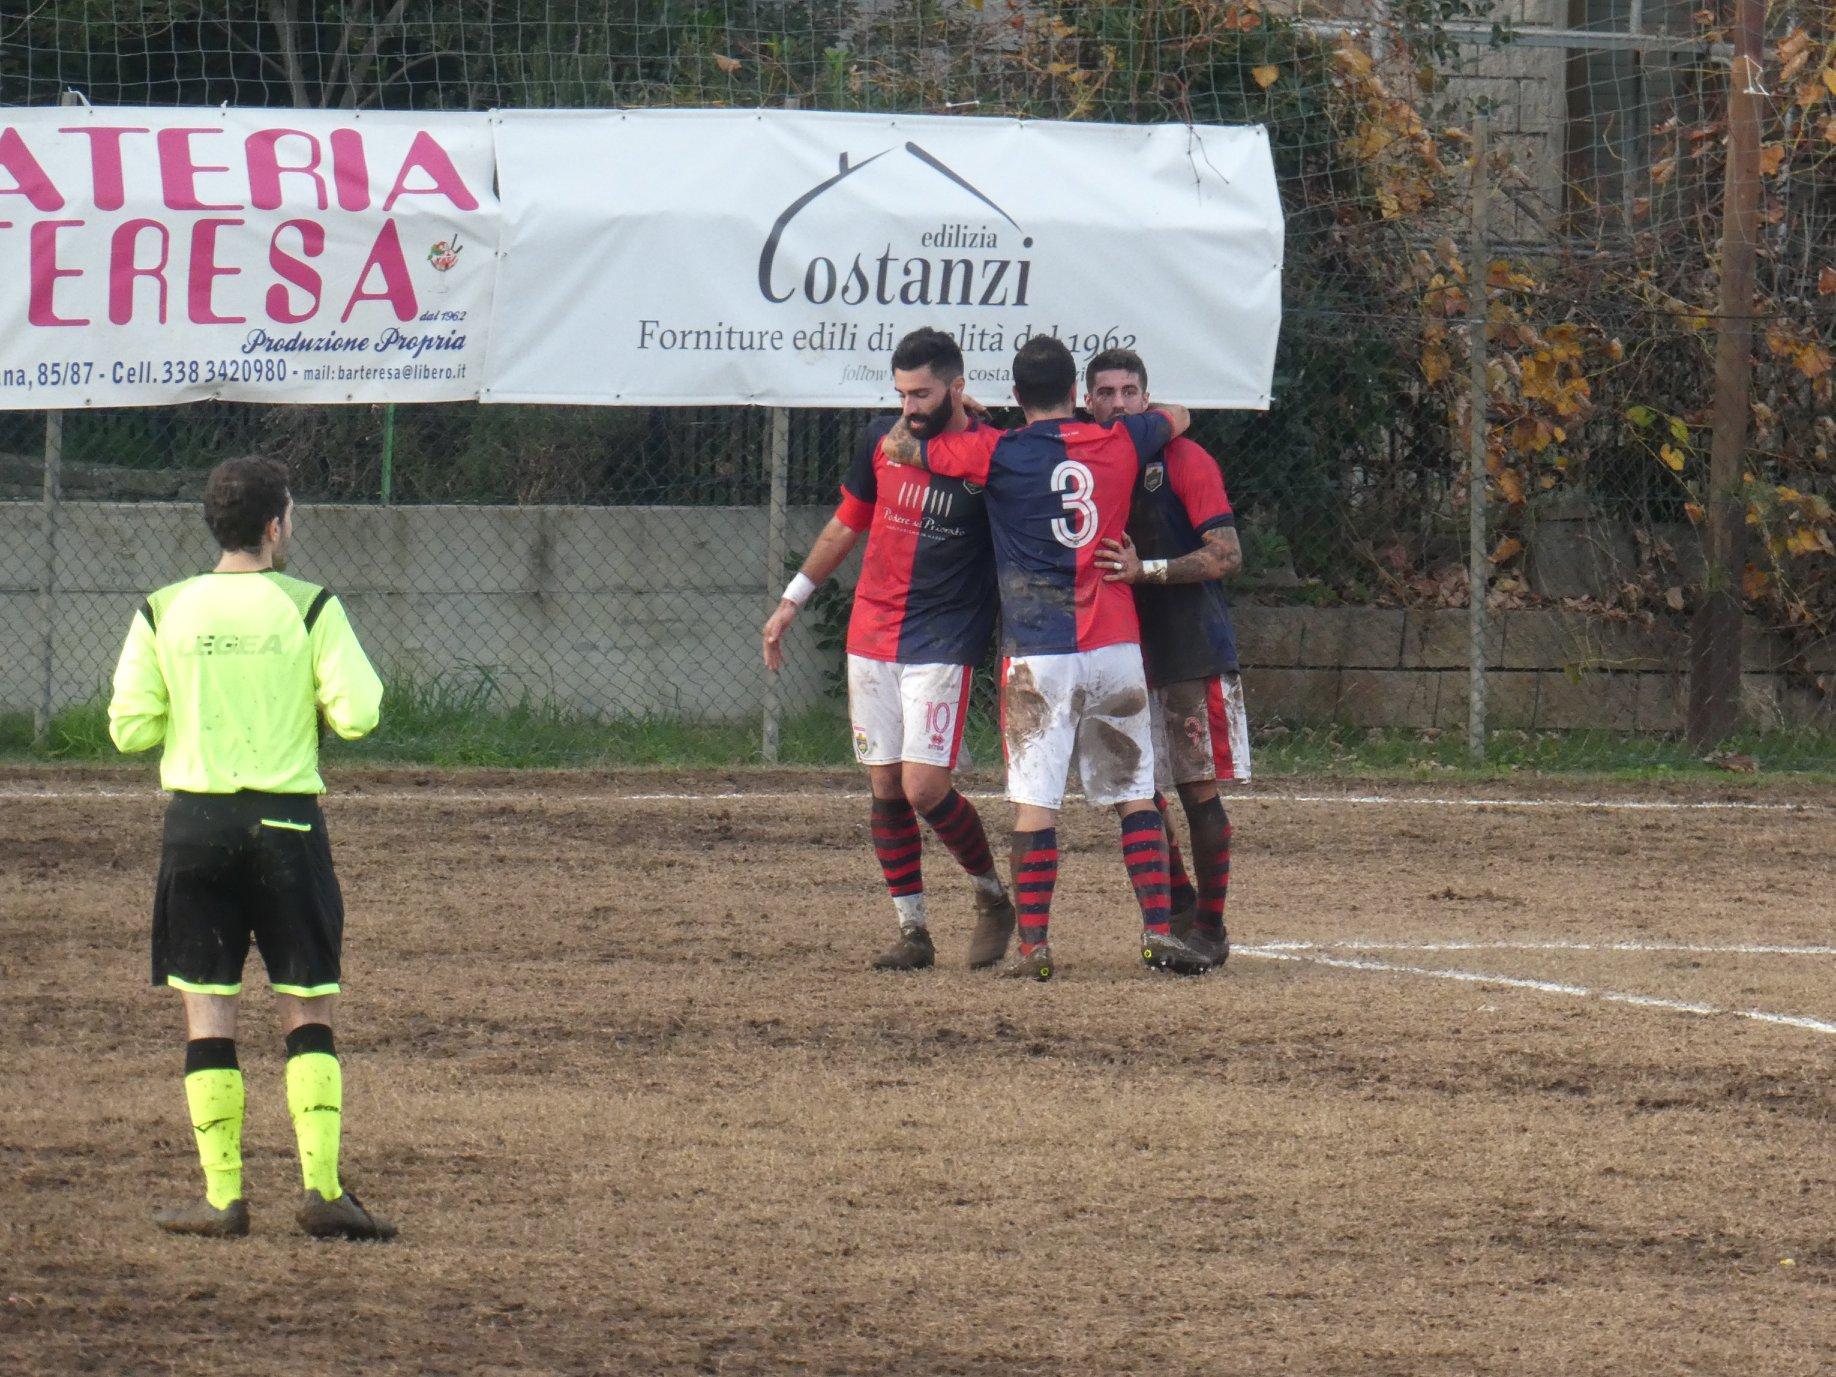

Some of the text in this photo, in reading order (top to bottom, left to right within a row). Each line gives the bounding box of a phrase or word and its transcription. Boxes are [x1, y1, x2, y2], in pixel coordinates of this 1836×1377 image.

[921, 224, 998, 249] edilizia
[0, 217, 419, 327] ERESA
[757, 232, 1034, 307] Costanzi
[419, 310, 467, 322] dal 1962
[241, 327, 467, 359] Produzione Propria
[636, 319, 784, 351] Forniture
[792, 321, 858, 351] edili
[867, 322, 895, 351] di
[1069, 325, 1137, 362] 1962
[0, 368, 33, 391] na,
[204, 358, 287, 384] 3420980
[1050, 460, 1098, 548] 3
[925, 701, 951, 734] 10
